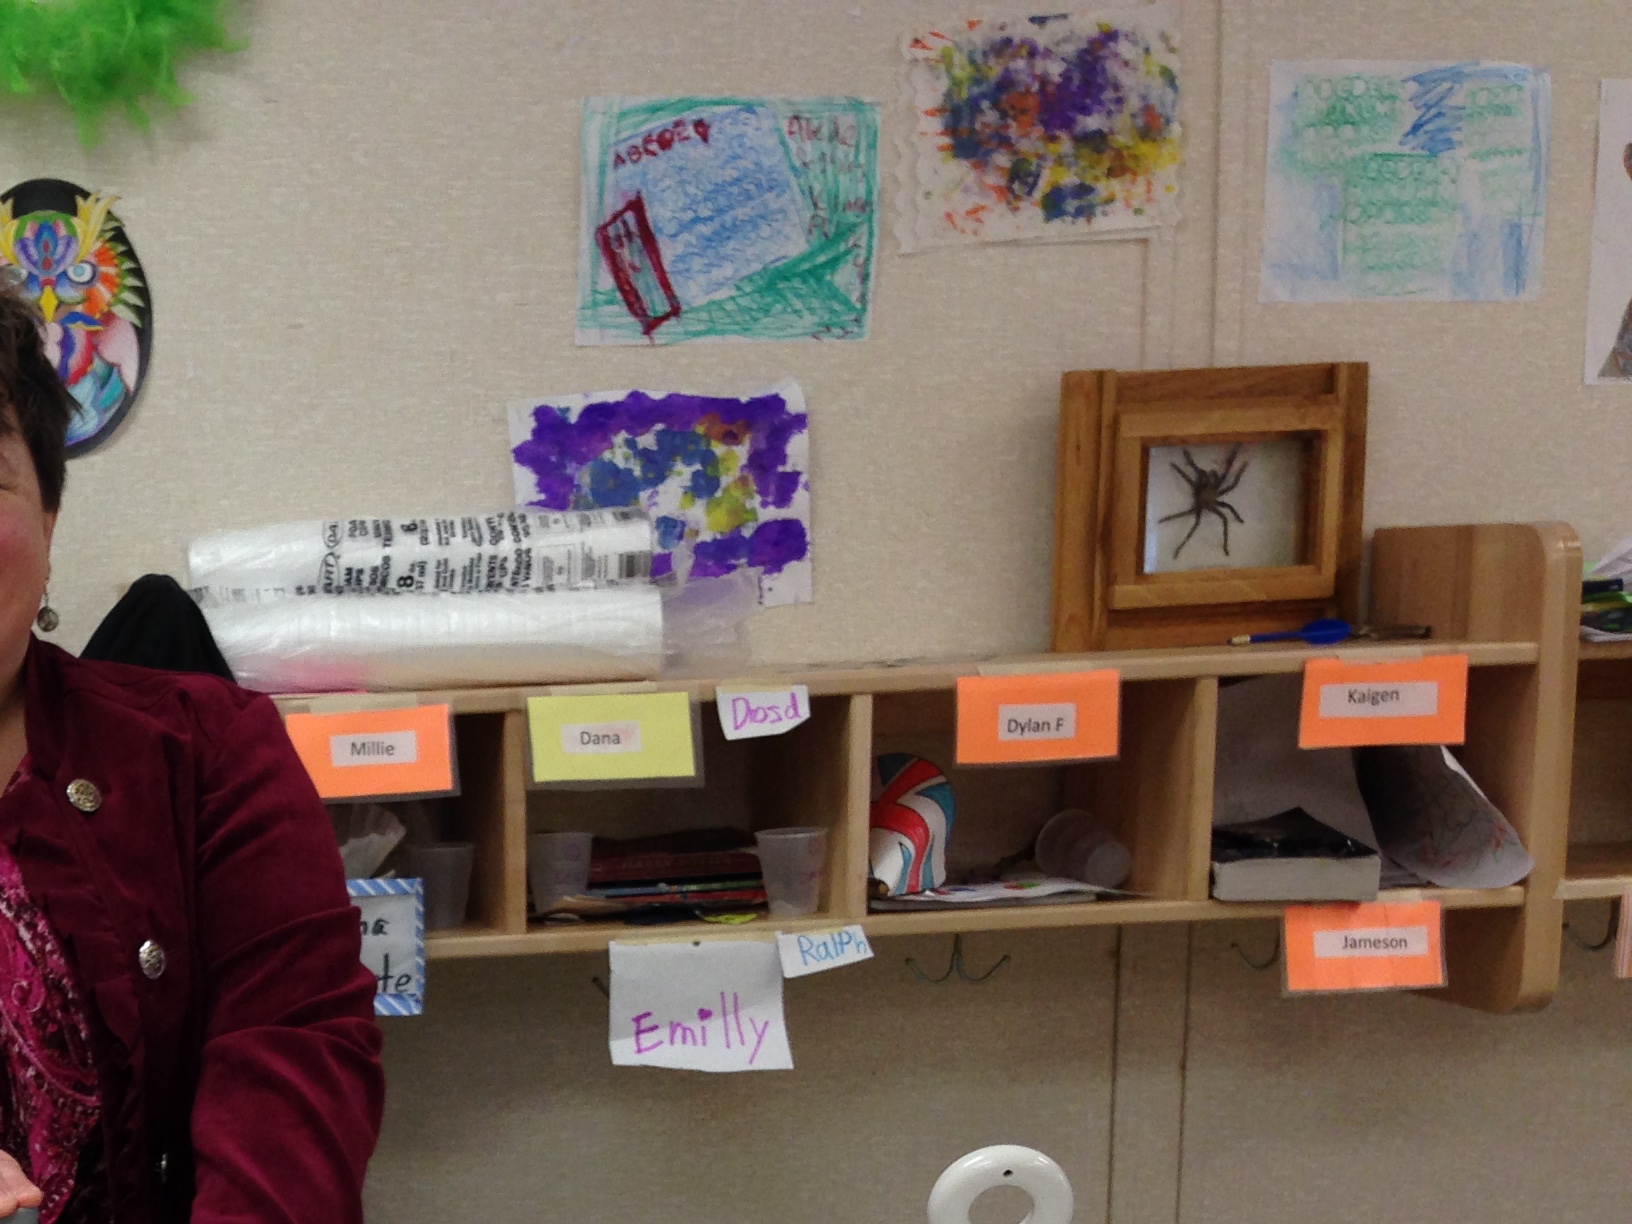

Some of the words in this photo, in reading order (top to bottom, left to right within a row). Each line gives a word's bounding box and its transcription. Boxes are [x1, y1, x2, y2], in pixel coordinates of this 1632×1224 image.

[1006, 716, 1049, 736] Dylan
[1055, 717, 1065, 733] F
[580, 730, 622, 747] Dana
[350, 741, 396, 758] Millie
[1341, 934, 1409, 951] Jameson
[632, 991, 769, 1066] Emilly
